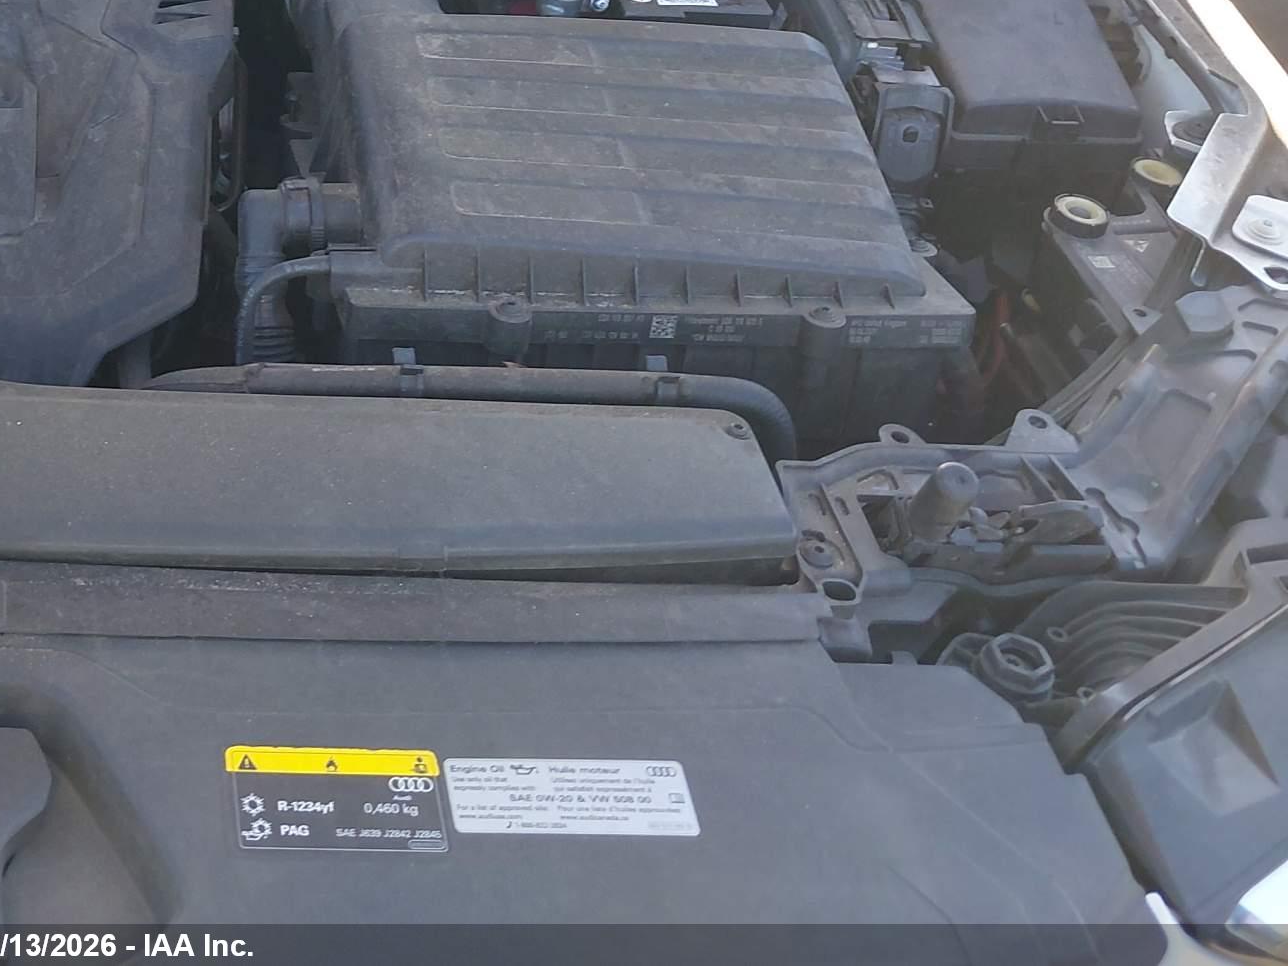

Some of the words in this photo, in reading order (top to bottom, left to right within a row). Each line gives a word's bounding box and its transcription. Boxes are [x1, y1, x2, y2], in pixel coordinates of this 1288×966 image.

[450, 765, 487, 774] Engine
[490, 765, 504, 773] Oil
[510, 794, 533, 802] SAE
[536, 794, 574, 803] 0W-20
[577, 795, 586, 803] &
[588, 795, 610, 803] VW
[637, 795, 652, 803] 00
[277, 800, 335, 814] R-1234yf
[402, 803, 419, 817] kg
[280, 824, 310, 836] PAG
[335, 828, 358, 837] SAE
